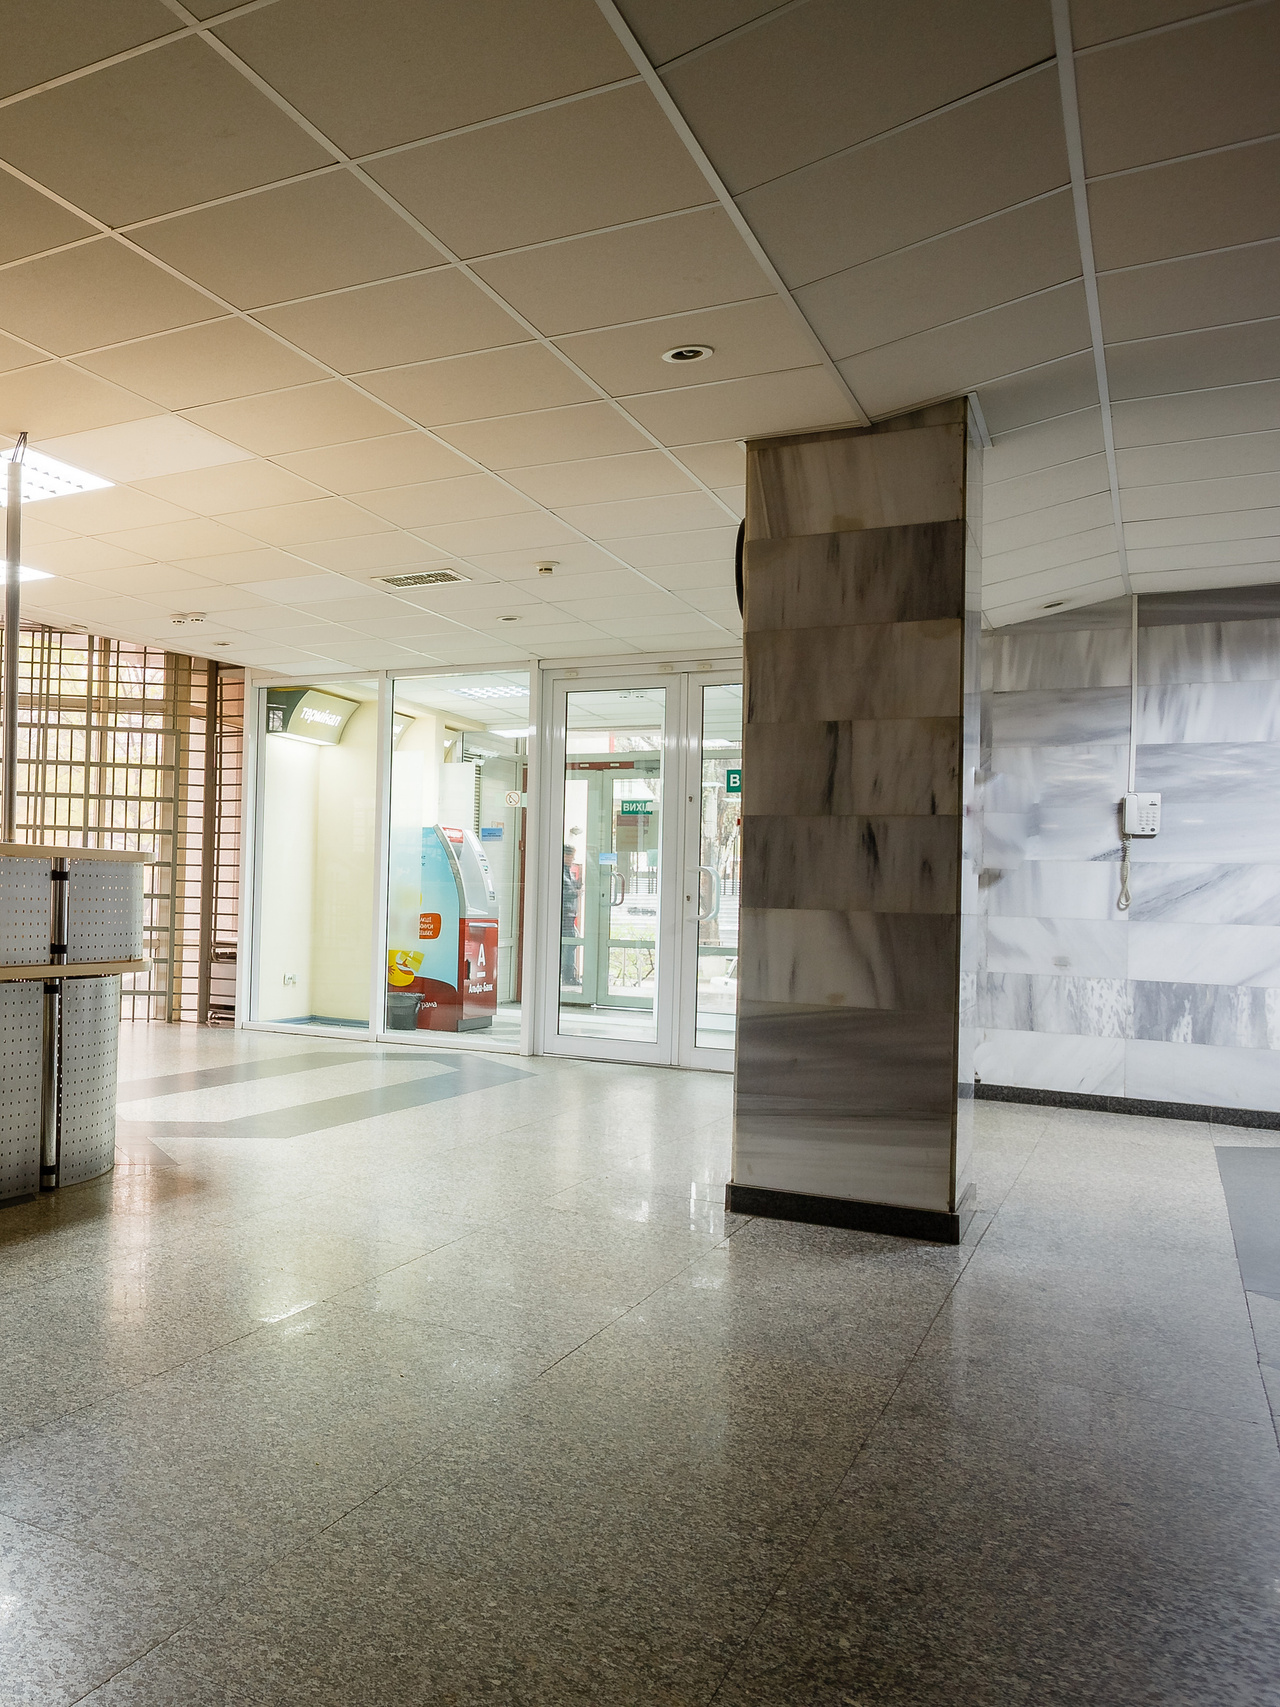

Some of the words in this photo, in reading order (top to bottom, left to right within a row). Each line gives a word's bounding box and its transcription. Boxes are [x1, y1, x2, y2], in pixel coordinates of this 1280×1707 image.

[300, 707, 342, 727] термінал
[730, 774, 740, 787] В
[420, 1001, 438, 1010] рама
